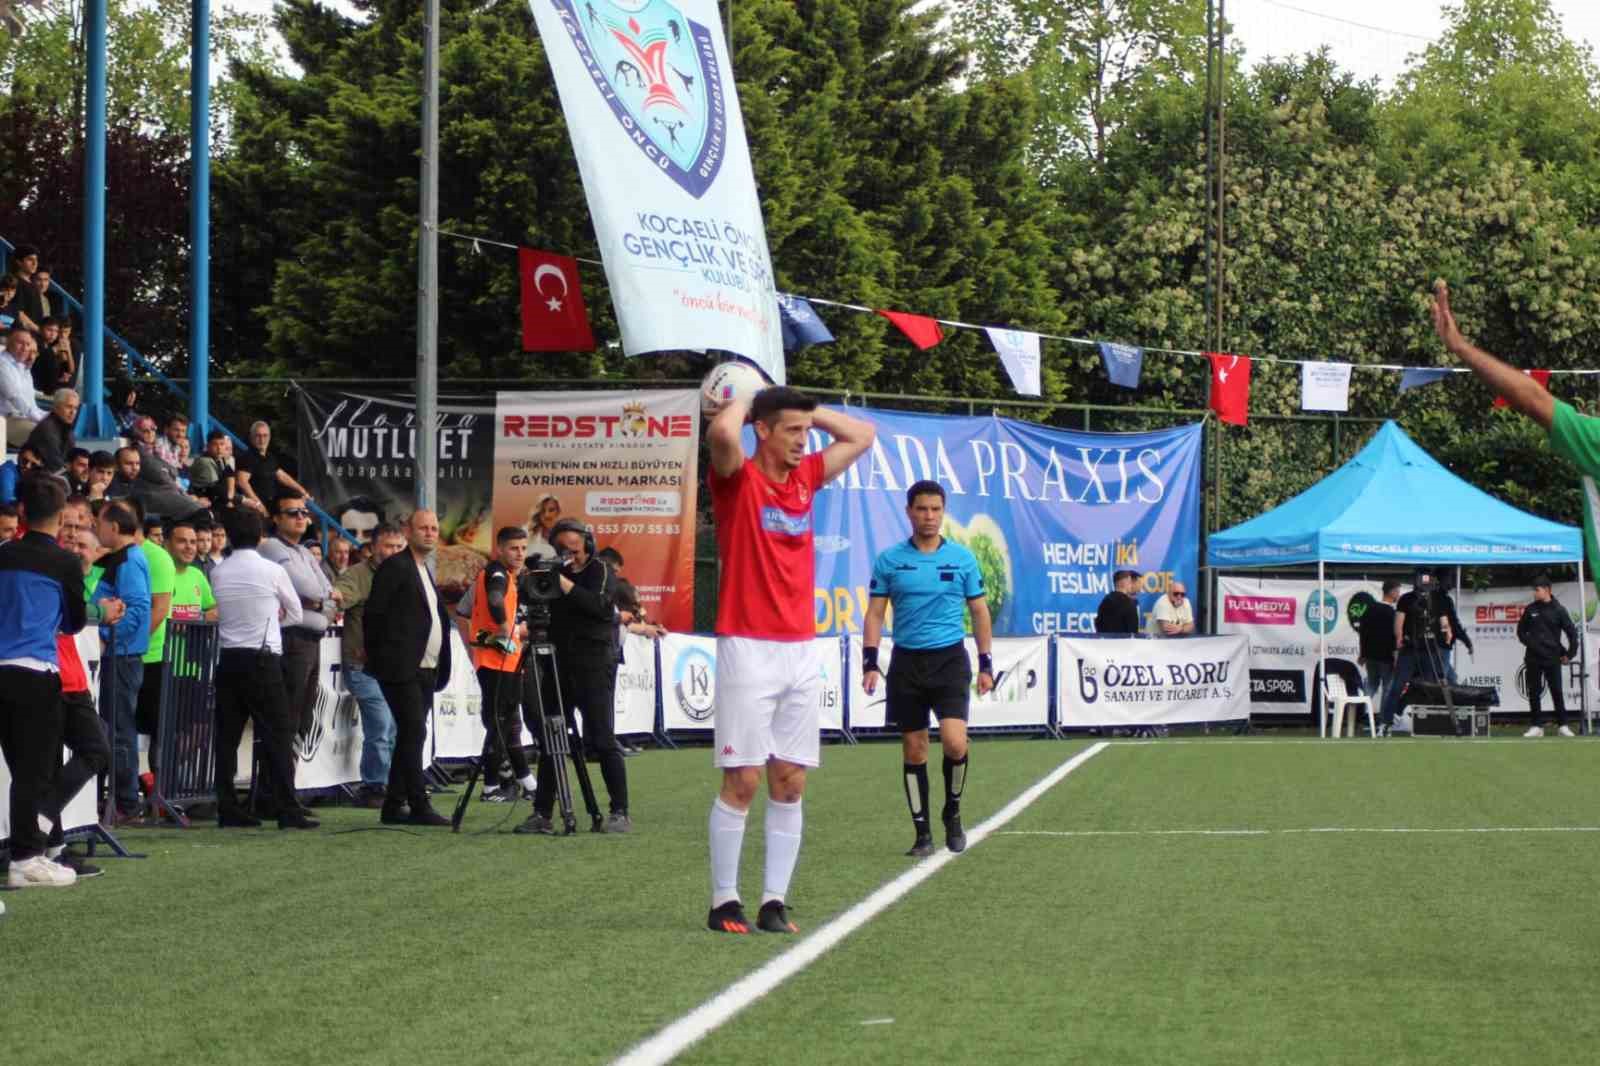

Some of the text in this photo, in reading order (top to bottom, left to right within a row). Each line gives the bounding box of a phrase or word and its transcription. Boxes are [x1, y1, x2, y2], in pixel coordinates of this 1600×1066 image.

[636, 211, 721, 241] KOCAELİ
[623, 232, 721, 268] GENÇLİK
[721, 247, 747, 273] VE
[503, 414, 692, 438] REDSTONE
[511, 459, 682, 470] TÜRKİYE'NİN EN HIZLI BÜYÜYEN
[968, 438, 1165, 505] PRAXIS
[511, 475, 682, 486] GAYRİMENKUL MARKASI
[623, 524, 645, 534] 707
[647, 524, 663, 534] 55
[1043, 537, 1139, 566] HEMEN İKİ
[1047, 566, 1110, 594] TESLİM
[1103, 659, 1231, 687] ÖZEL BORU
[1103, 688, 1146, 703] SANAYİ
[1149, 689, 1164, 702] VE
[1167, 688, 1209, 701] TİCARET
